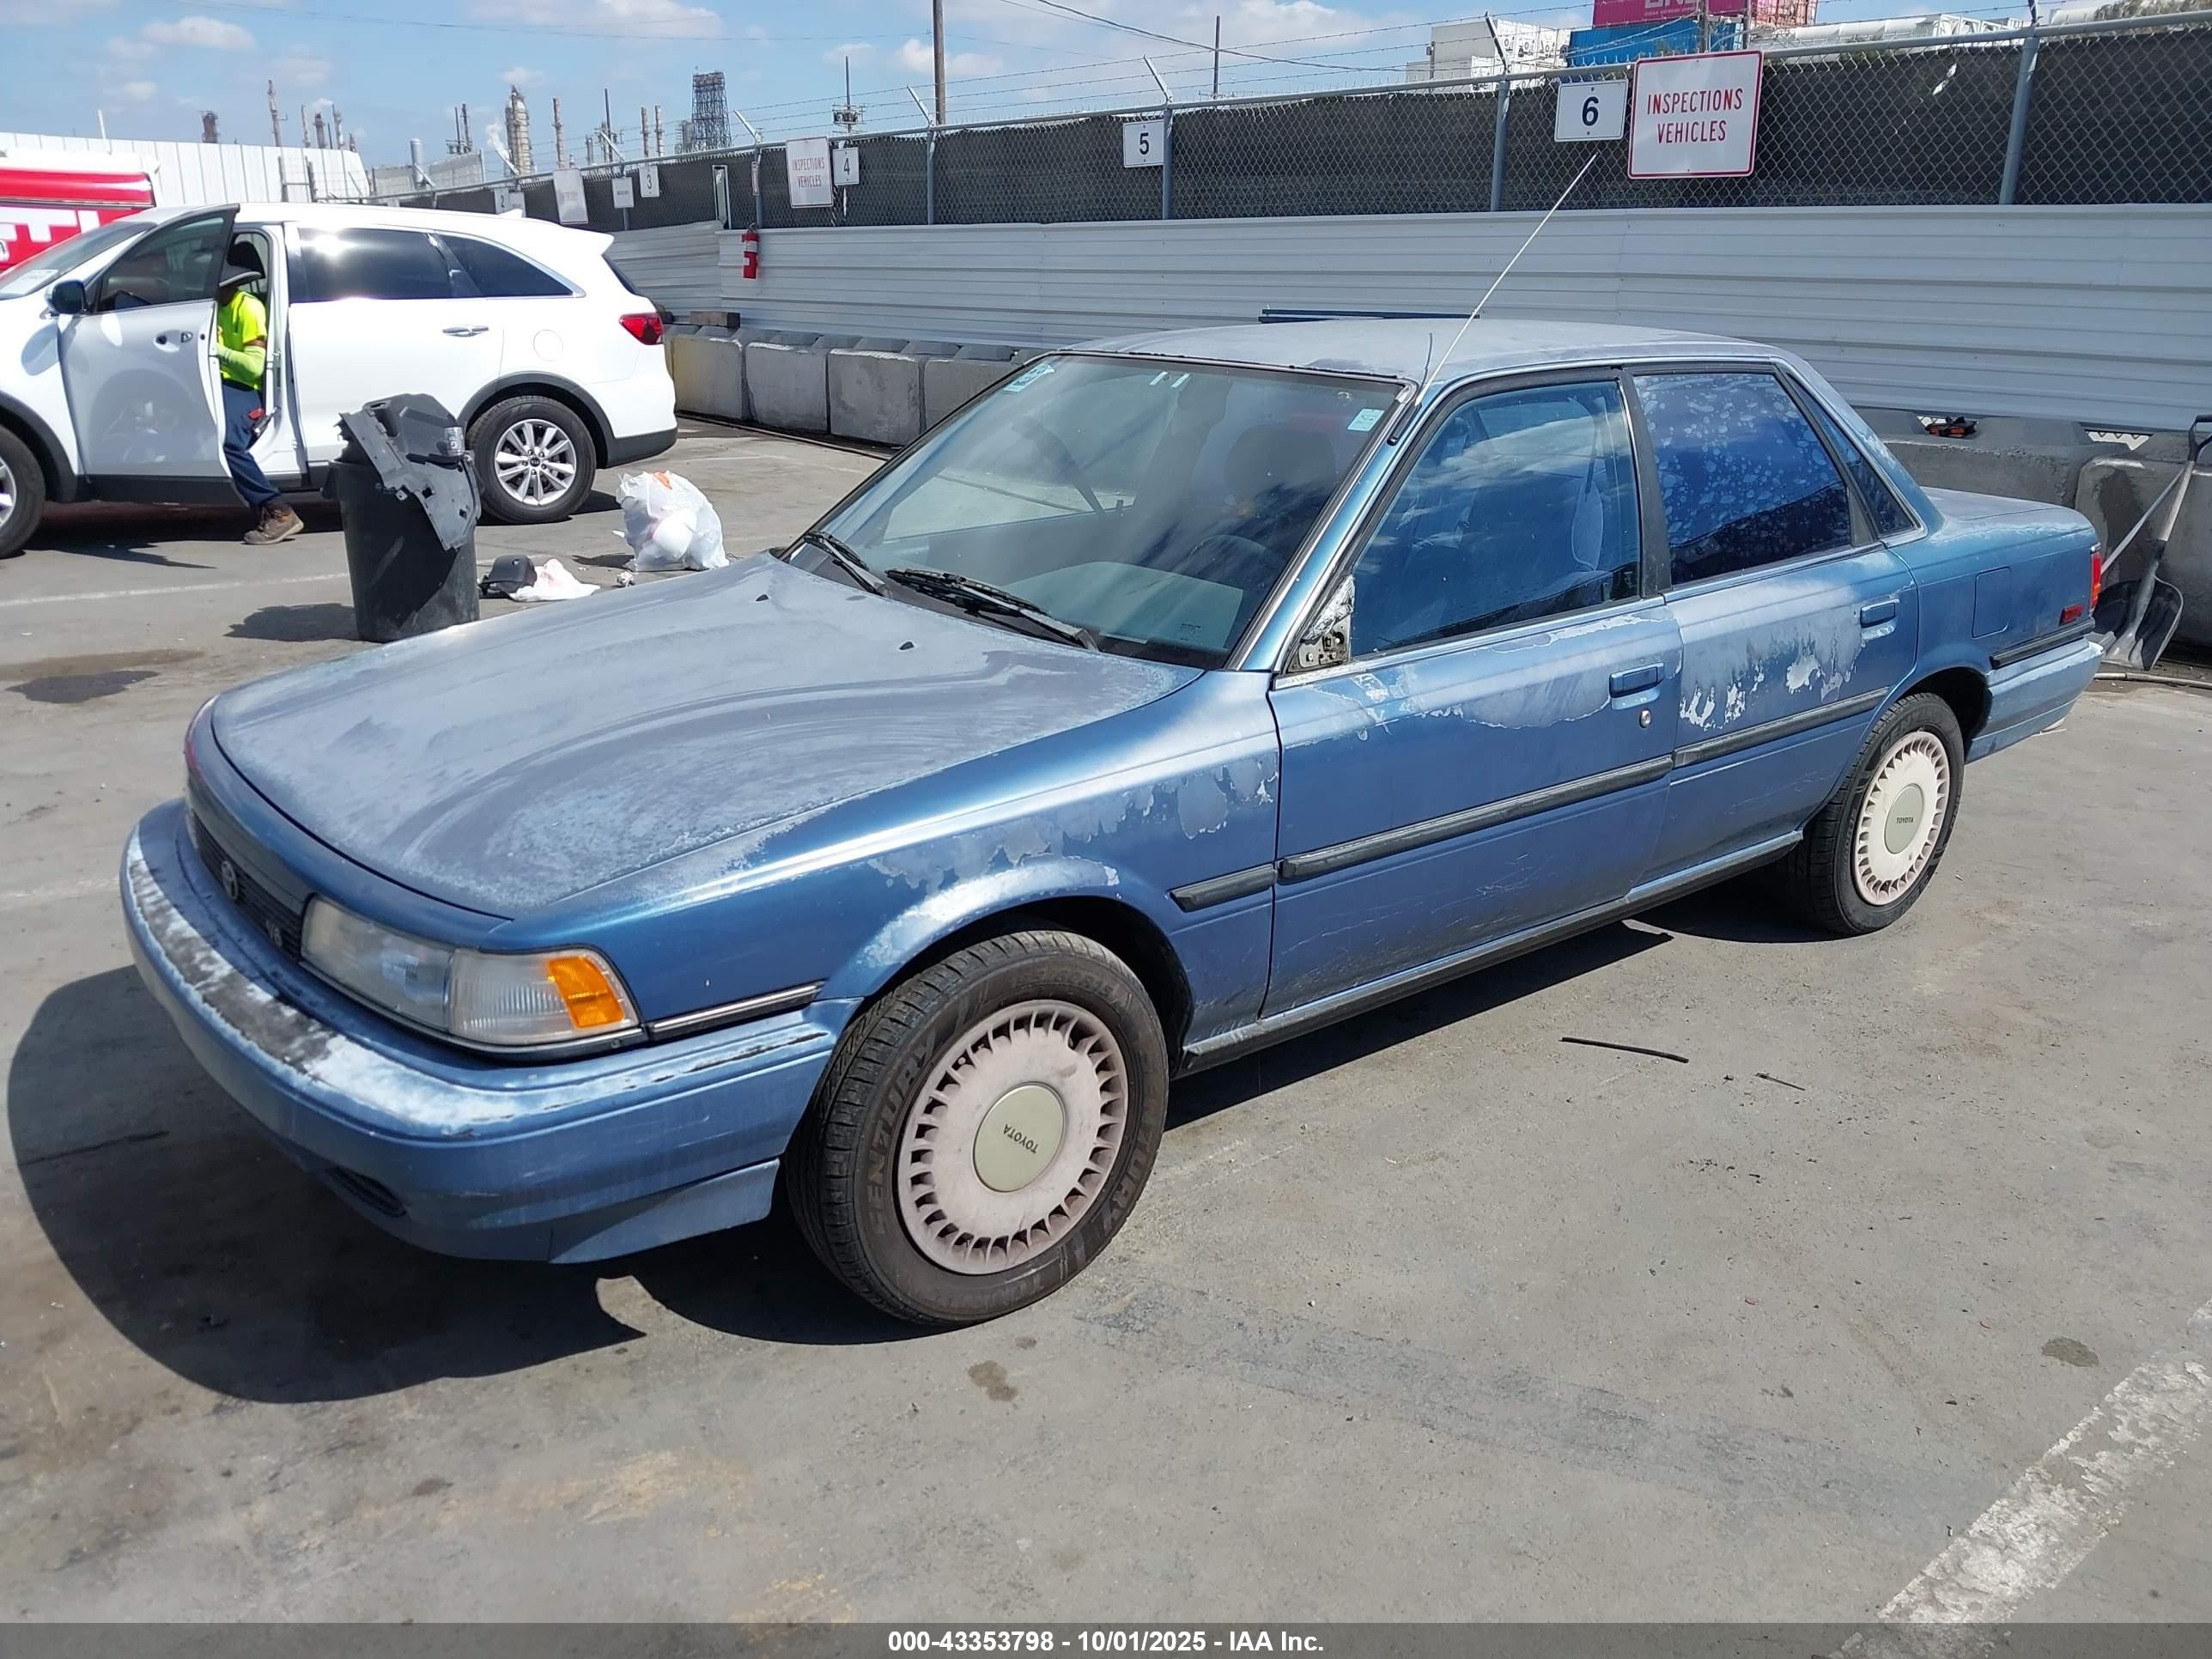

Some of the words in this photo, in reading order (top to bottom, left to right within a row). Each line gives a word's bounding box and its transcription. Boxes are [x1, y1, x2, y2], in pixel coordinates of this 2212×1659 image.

[1581, 95, 1600, 126] 6
[1647, 88, 1744, 116] INSPECTIONS
[1657, 119, 1728, 144] VEHICLES
[1139, 131, 1150, 155] 5
[792, 156, 825, 171] INSPECTIONS
[843, 157, 851, 176] 4
[647, 173, 653, 190] 3
[797, 174, 822, 188] VEHICLES
[500, 194, 506, 209] 2
[1003, 1123, 1039, 1154] TOYOTA
